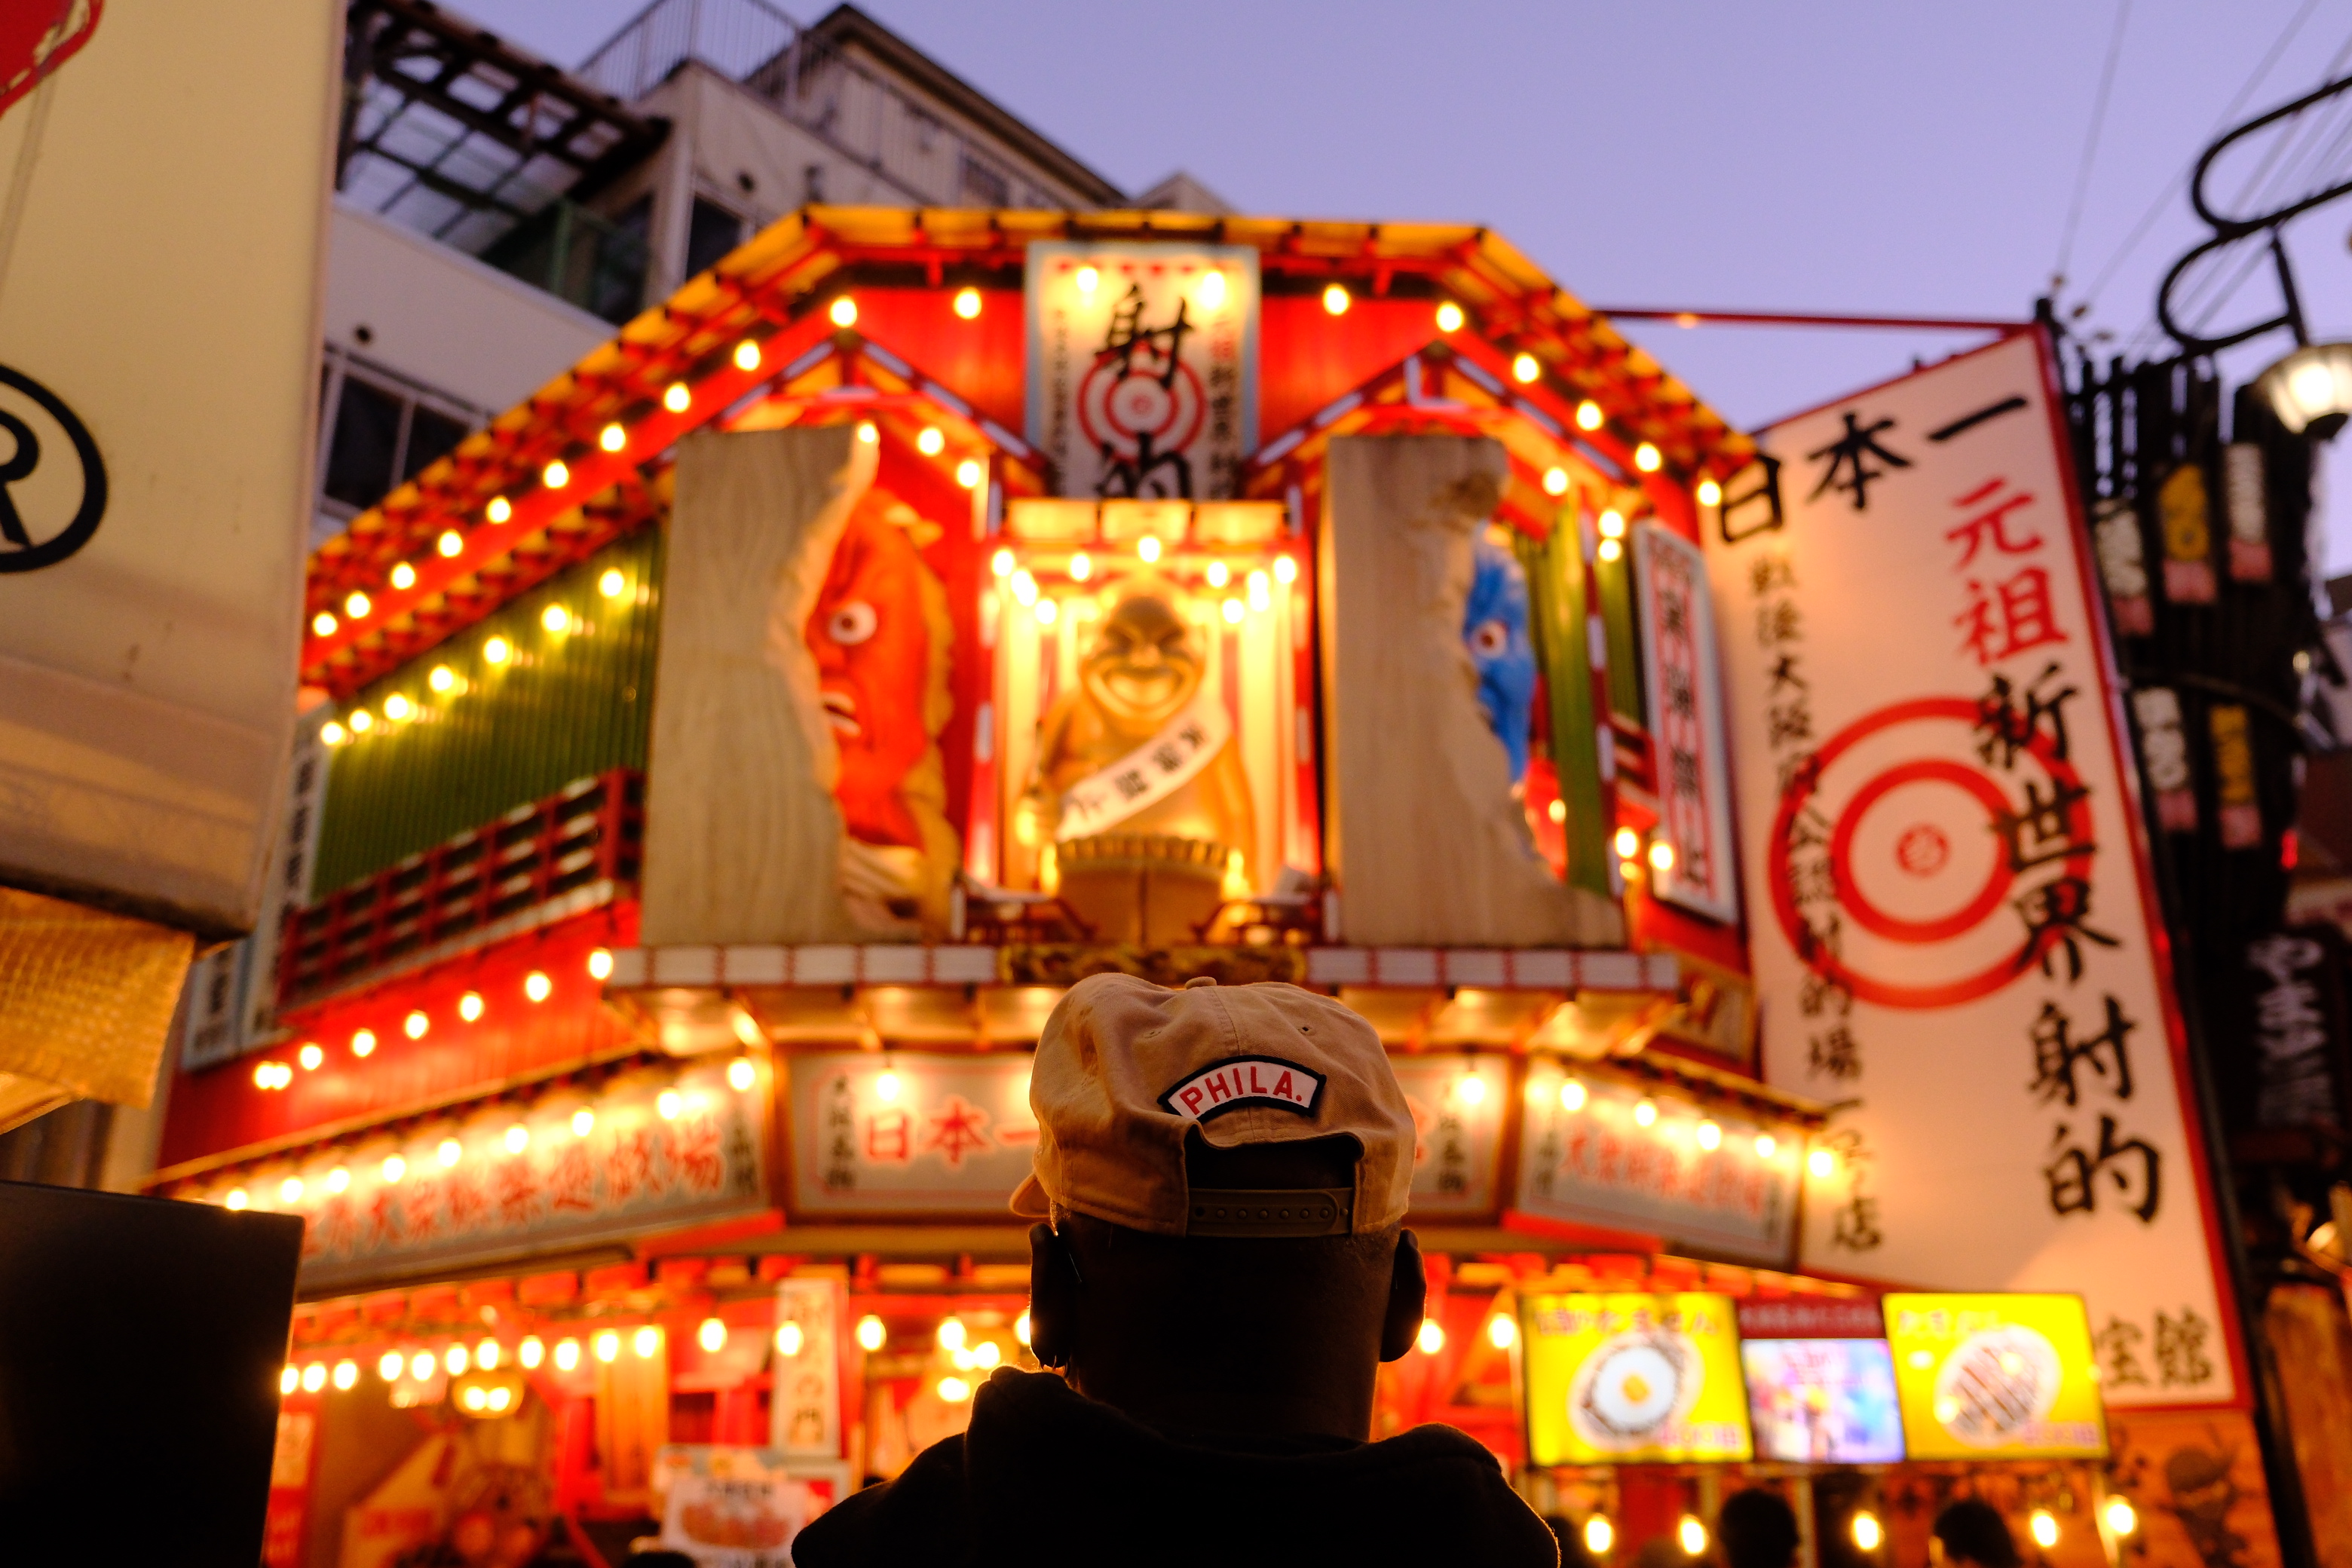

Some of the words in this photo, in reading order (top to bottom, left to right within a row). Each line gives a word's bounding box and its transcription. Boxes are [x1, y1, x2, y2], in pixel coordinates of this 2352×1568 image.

[1720, 395, 2029, 544] 日本一
[1179, 1065, 1303, 1116] PHILA.
